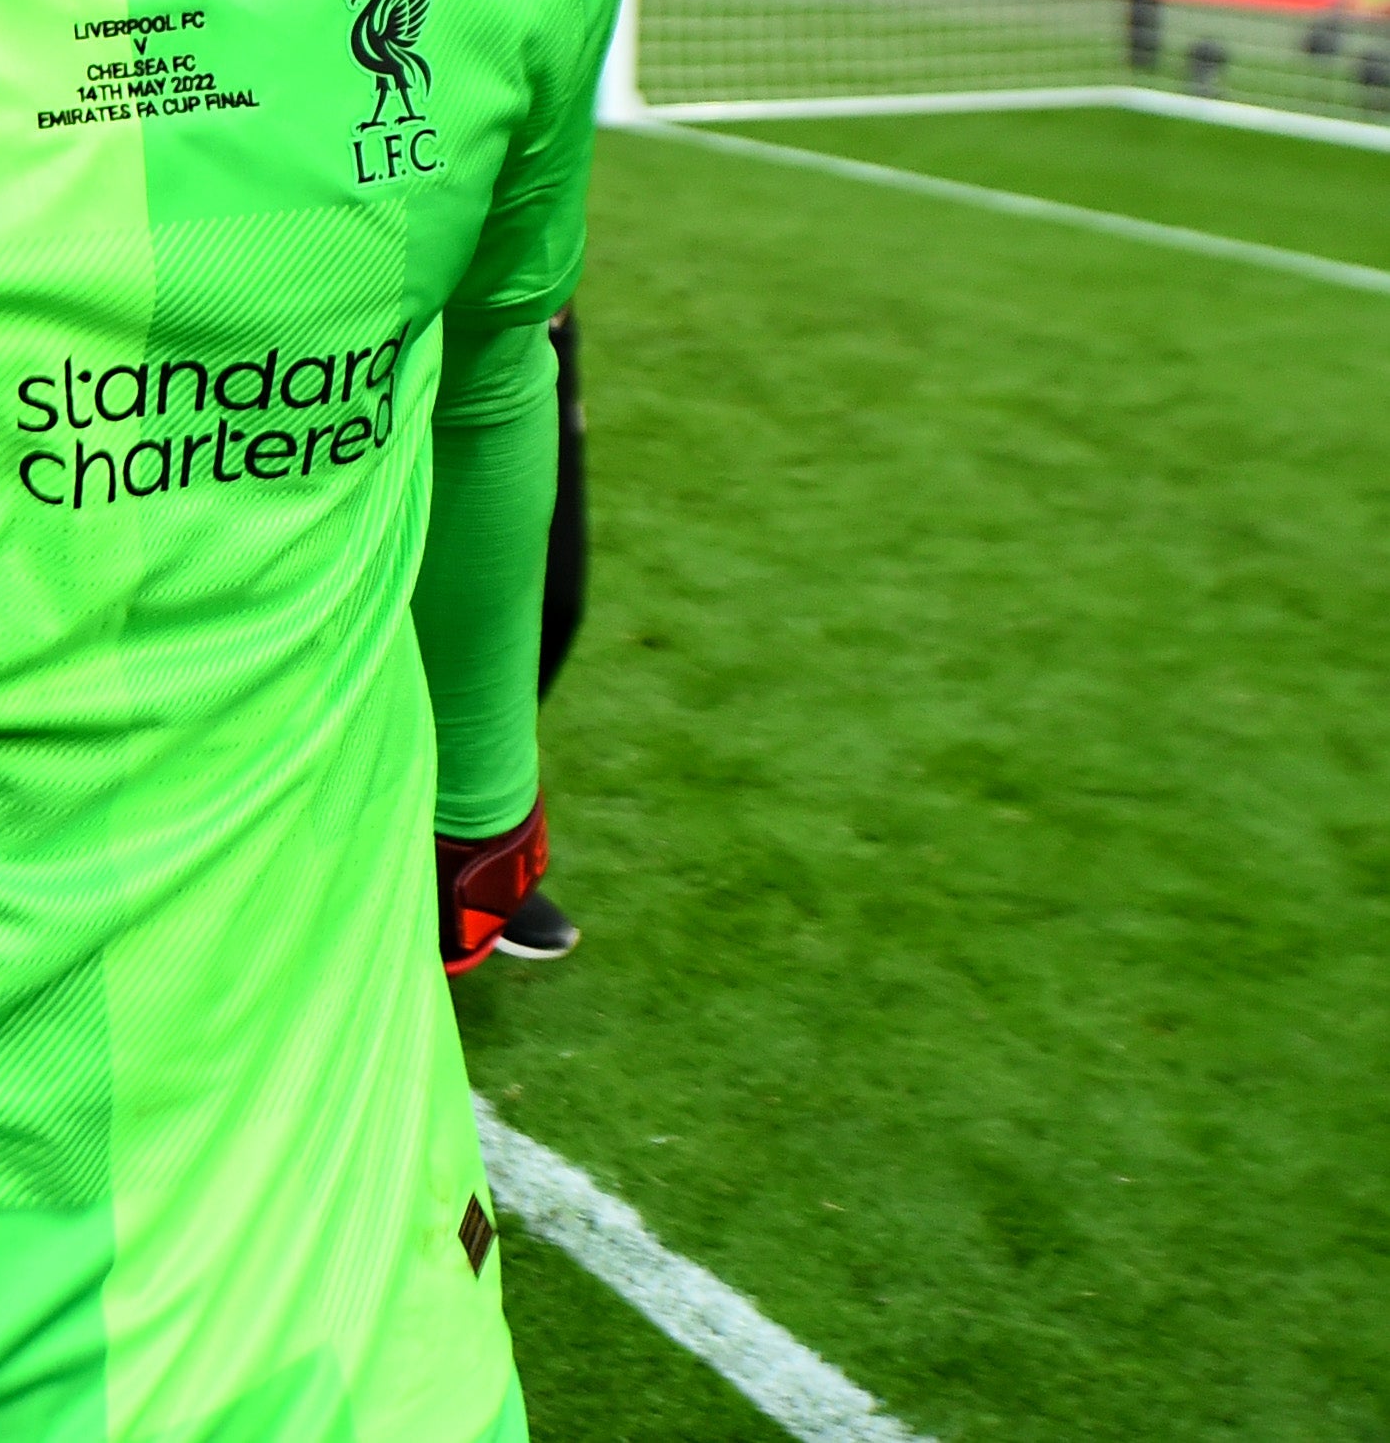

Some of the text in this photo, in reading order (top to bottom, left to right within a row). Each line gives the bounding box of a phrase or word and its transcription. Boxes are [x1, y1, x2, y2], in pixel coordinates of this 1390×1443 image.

[74, 11, 205, 40] LIVERPOOL FC
[133, 37, 148, 55] V
[87, 54, 196, 81] CHELSEA FC
[77, 72, 217, 102] 14TH MAY 2022
[37, 89, 260, 129] EMIRATES FA CUP FINAL
[353, 129, 445, 184] L.F.C.
[17, 319, 412, 432] standard
[18, 373, 395, 509] chartered
